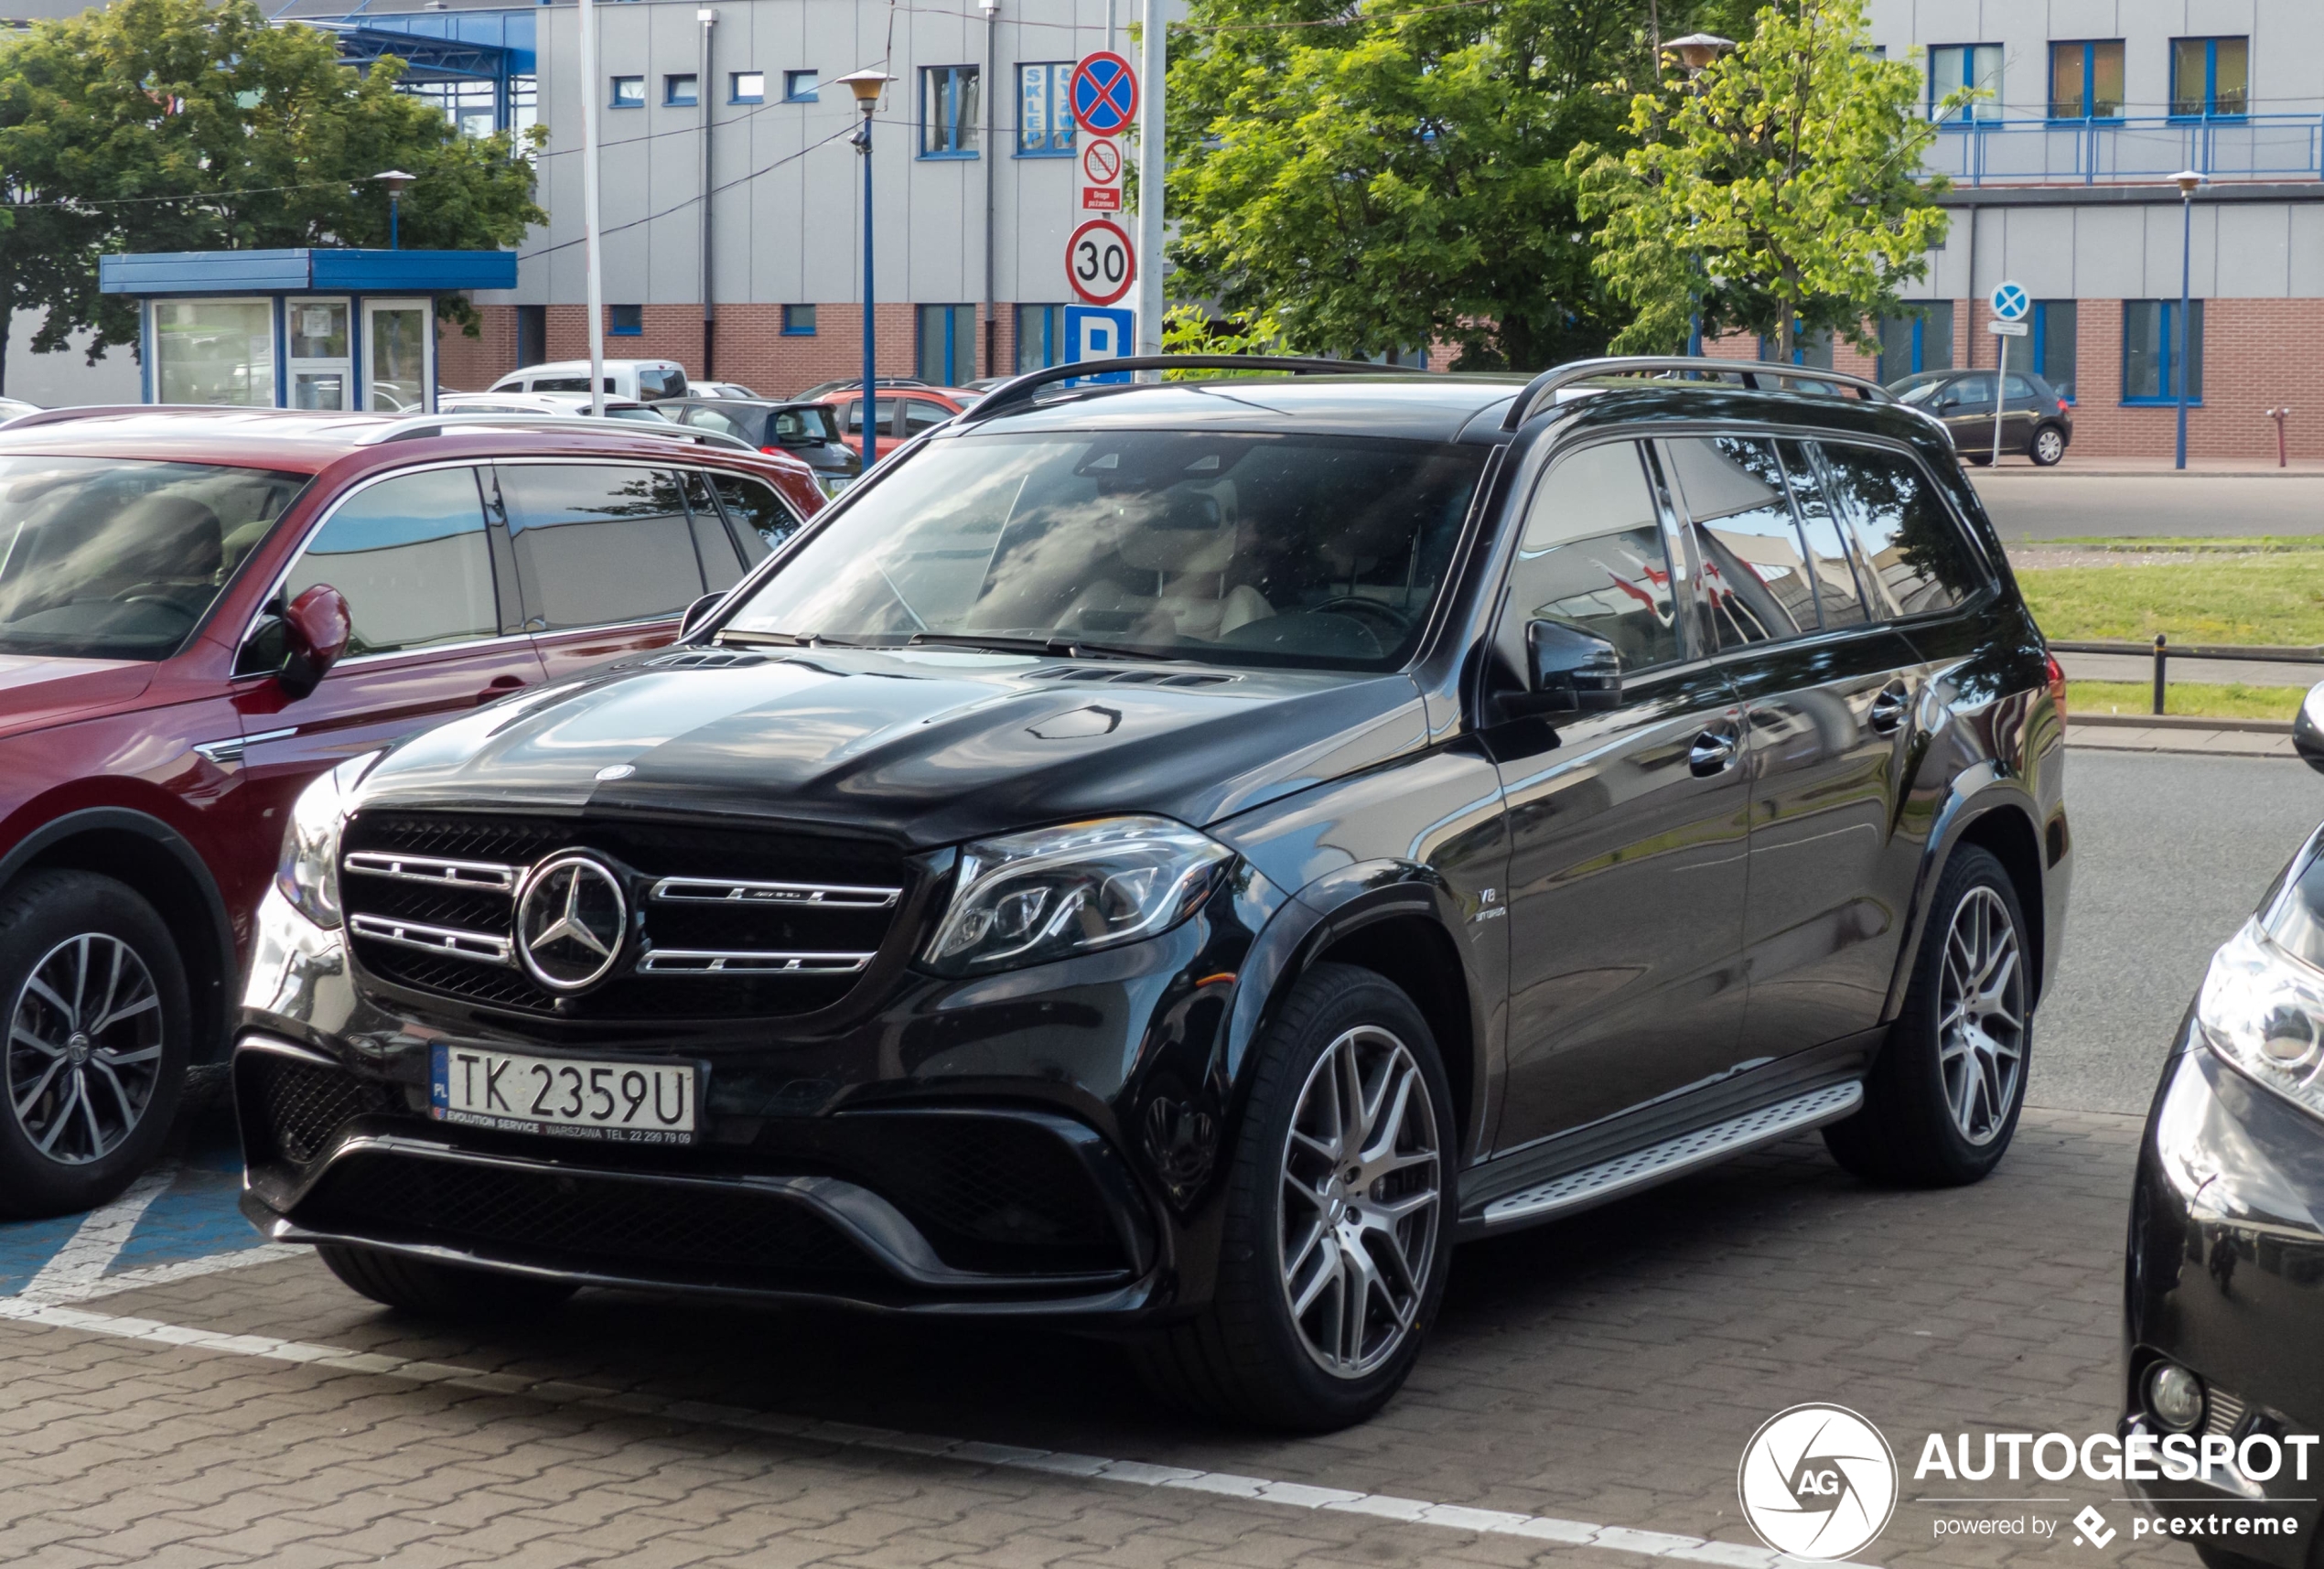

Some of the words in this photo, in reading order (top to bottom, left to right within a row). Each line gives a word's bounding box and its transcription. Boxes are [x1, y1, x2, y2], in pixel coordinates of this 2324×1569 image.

[1026, 69, 1041, 145] SKLEP
[1077, 241, 1124, 283] 30
[1080, 316, 1118, 381] P
[1478, 887, 1496, 903] V8
[433, 1082, 447, 1098] PL
[457, 1053, 512, 1112] TK
[531, 1063, 683, 1125] 2359U
[447, 1110, 496, 1127] EVOLUTION
[497, 1118, 540, 1134] SERVICE
[545, 1124, 603, 1139] WARSZAWA
[629, 1130, 642, 1141] 22
